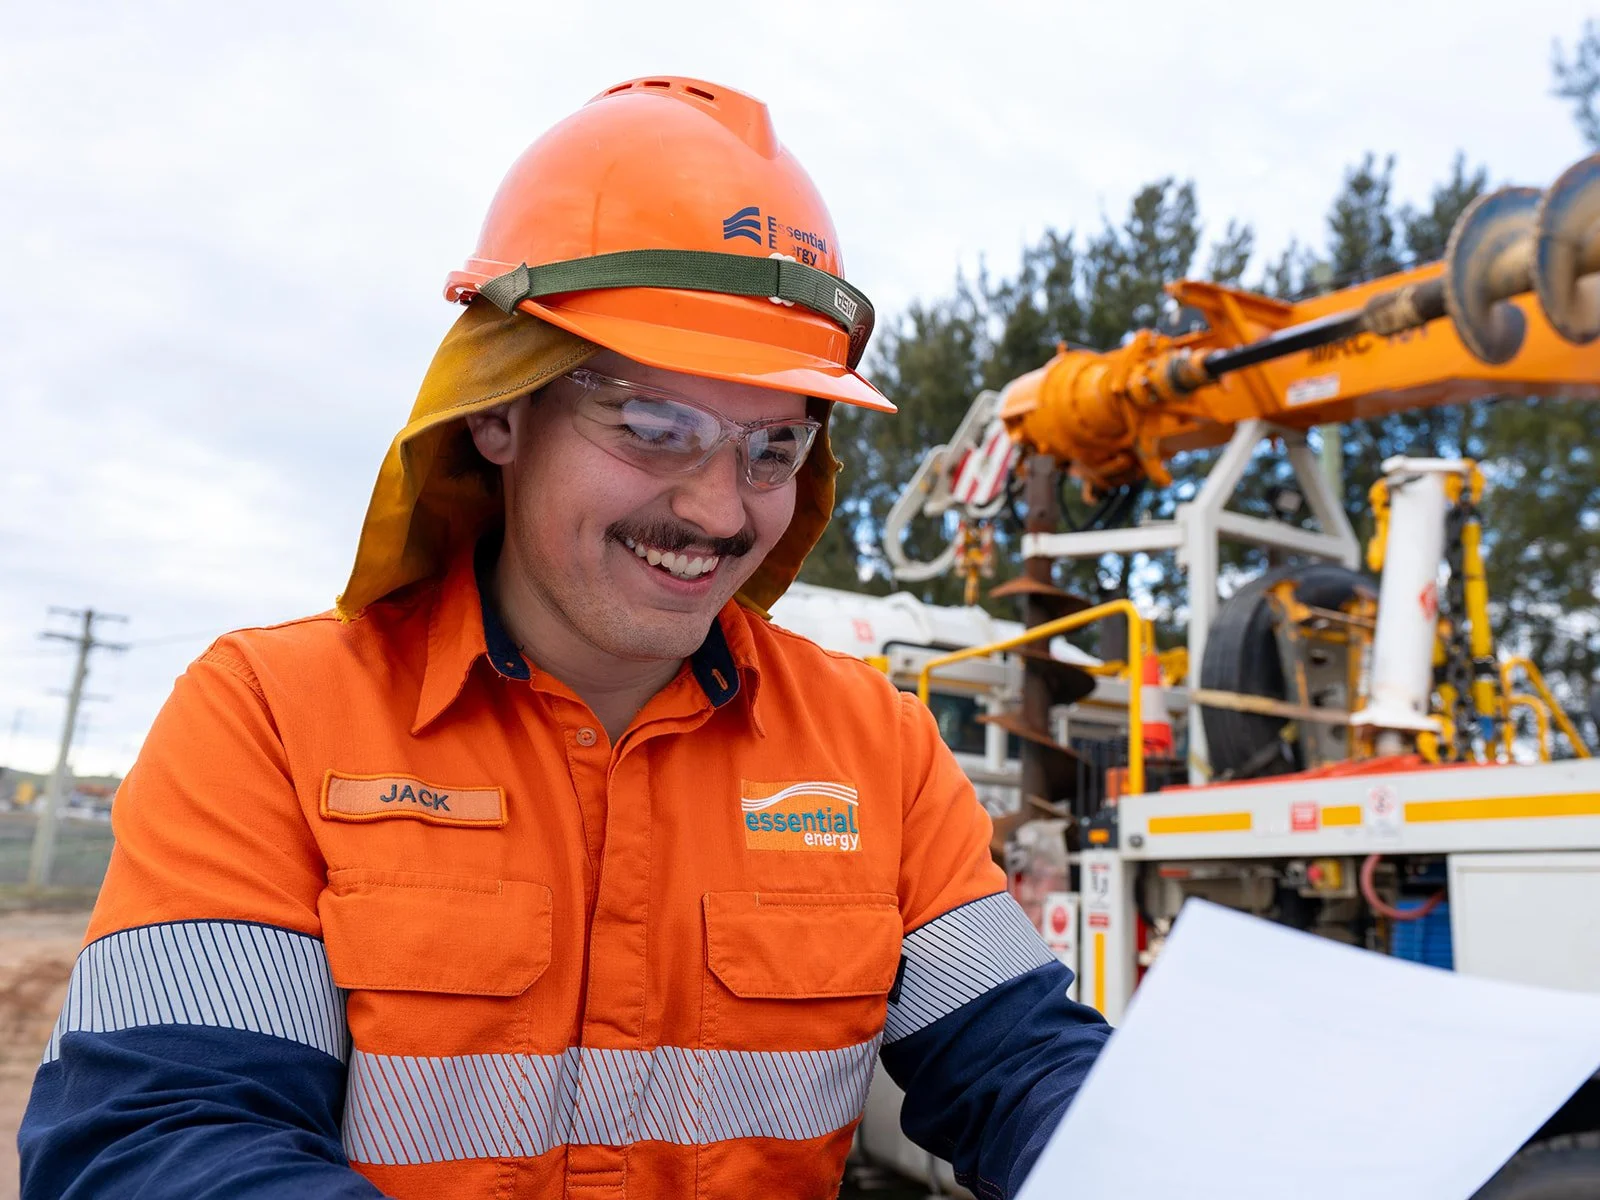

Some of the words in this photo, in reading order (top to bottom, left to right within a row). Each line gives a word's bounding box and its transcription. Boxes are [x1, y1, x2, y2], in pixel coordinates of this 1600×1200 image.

[768, 233, 817, 266] Ergy
[380, 784, 450, 812] JACK
[745, 804, 858, 834] essential
[804, 832, 859, 851] energy
